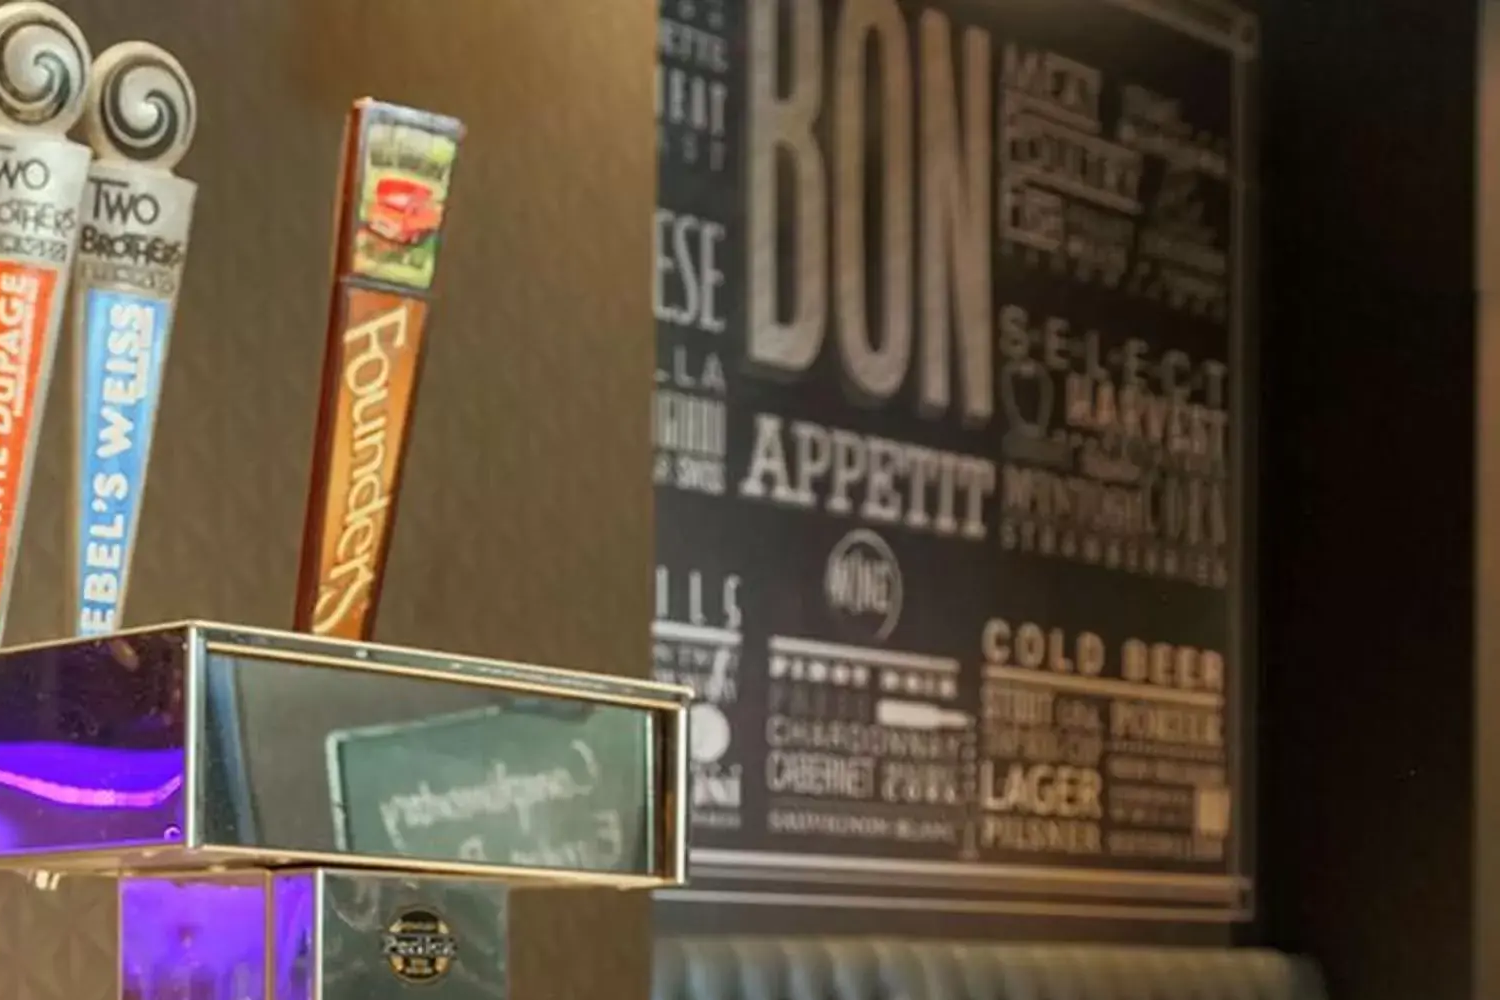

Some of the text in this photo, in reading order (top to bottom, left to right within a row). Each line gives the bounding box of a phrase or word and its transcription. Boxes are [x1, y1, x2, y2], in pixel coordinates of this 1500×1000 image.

[89, 177, 160, 226] TWO
[746, 0, 992, 418] BON
[96, 300, 142, 460] WEISS
[740, 411, 997, 538] APPETIT
[81, 470, 129, 635] EBEL'S
[982, 618, 1106, 676] COLD
[980, 759, 1101, 822] LAGER
